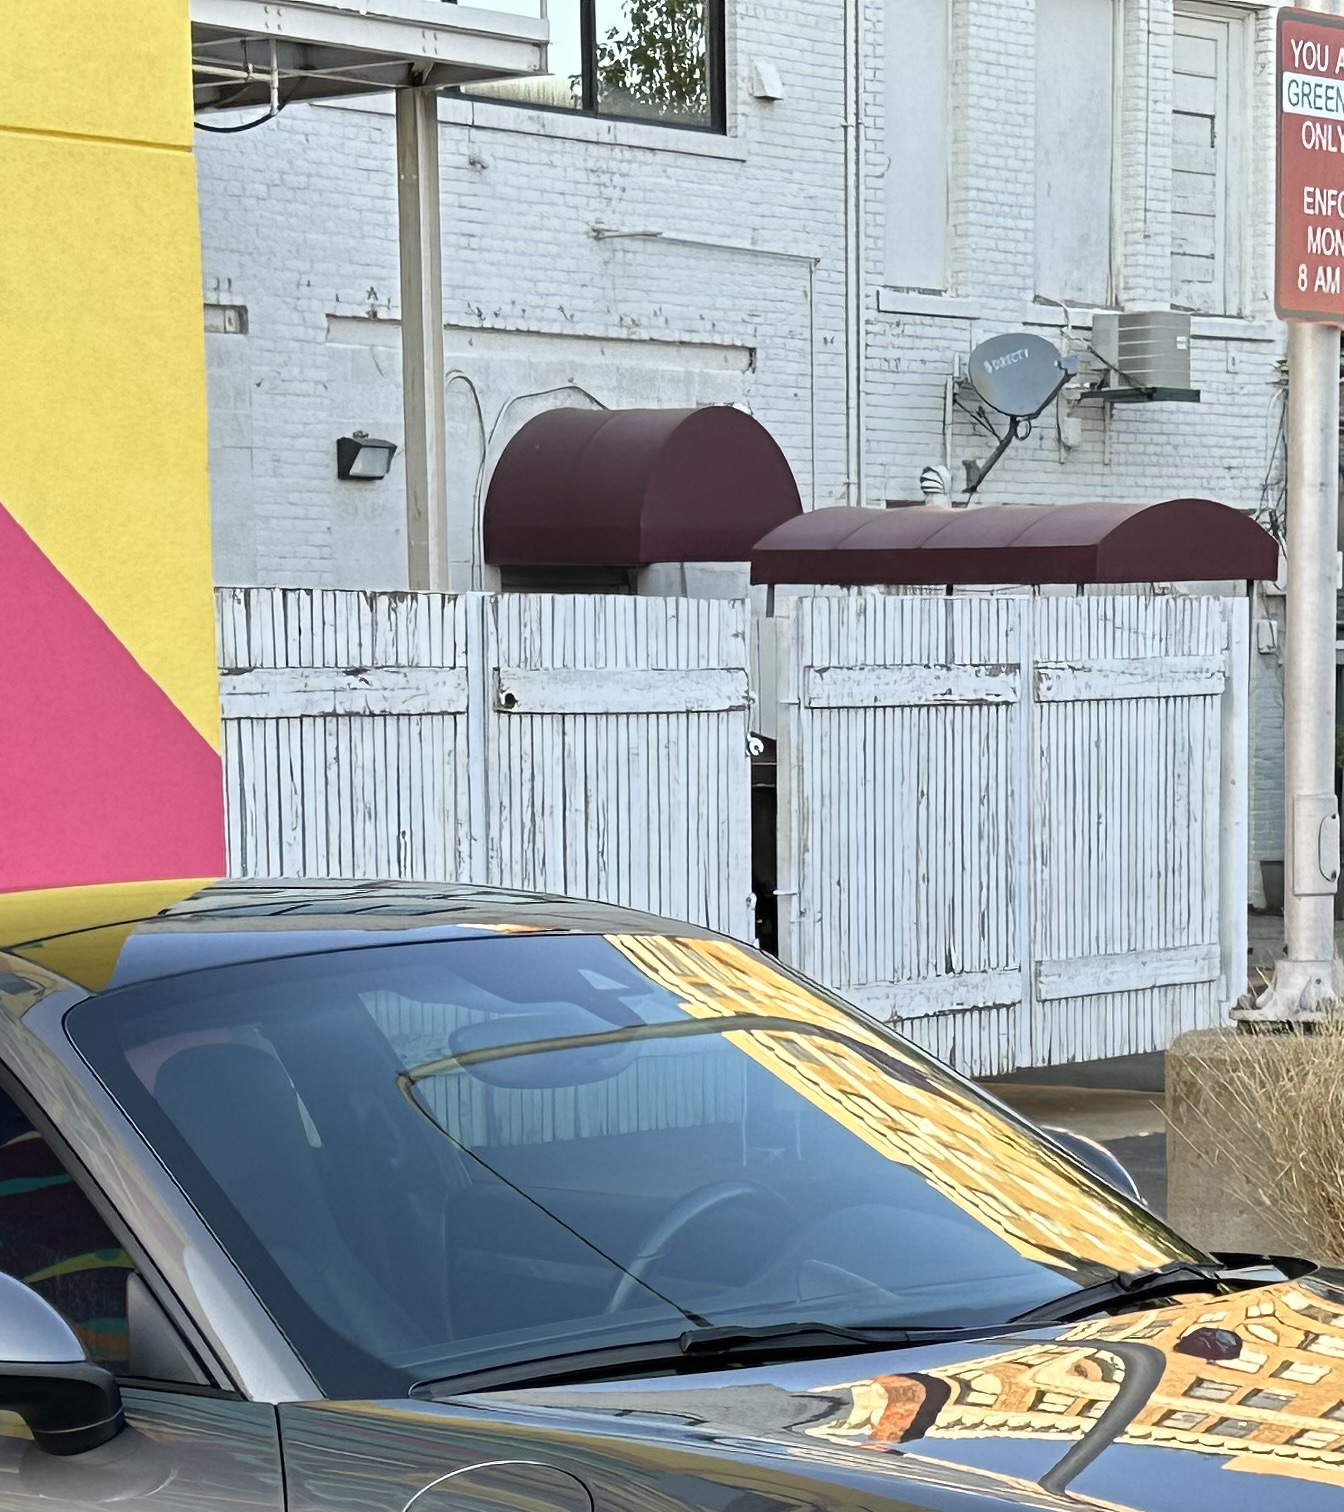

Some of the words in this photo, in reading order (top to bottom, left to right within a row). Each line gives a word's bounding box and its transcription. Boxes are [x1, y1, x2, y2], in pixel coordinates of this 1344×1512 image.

[1290, 38, 1329, 72] YOU
[1297, 264, 1308, 291] 8
[1314, 267, 1340, 294] AM
